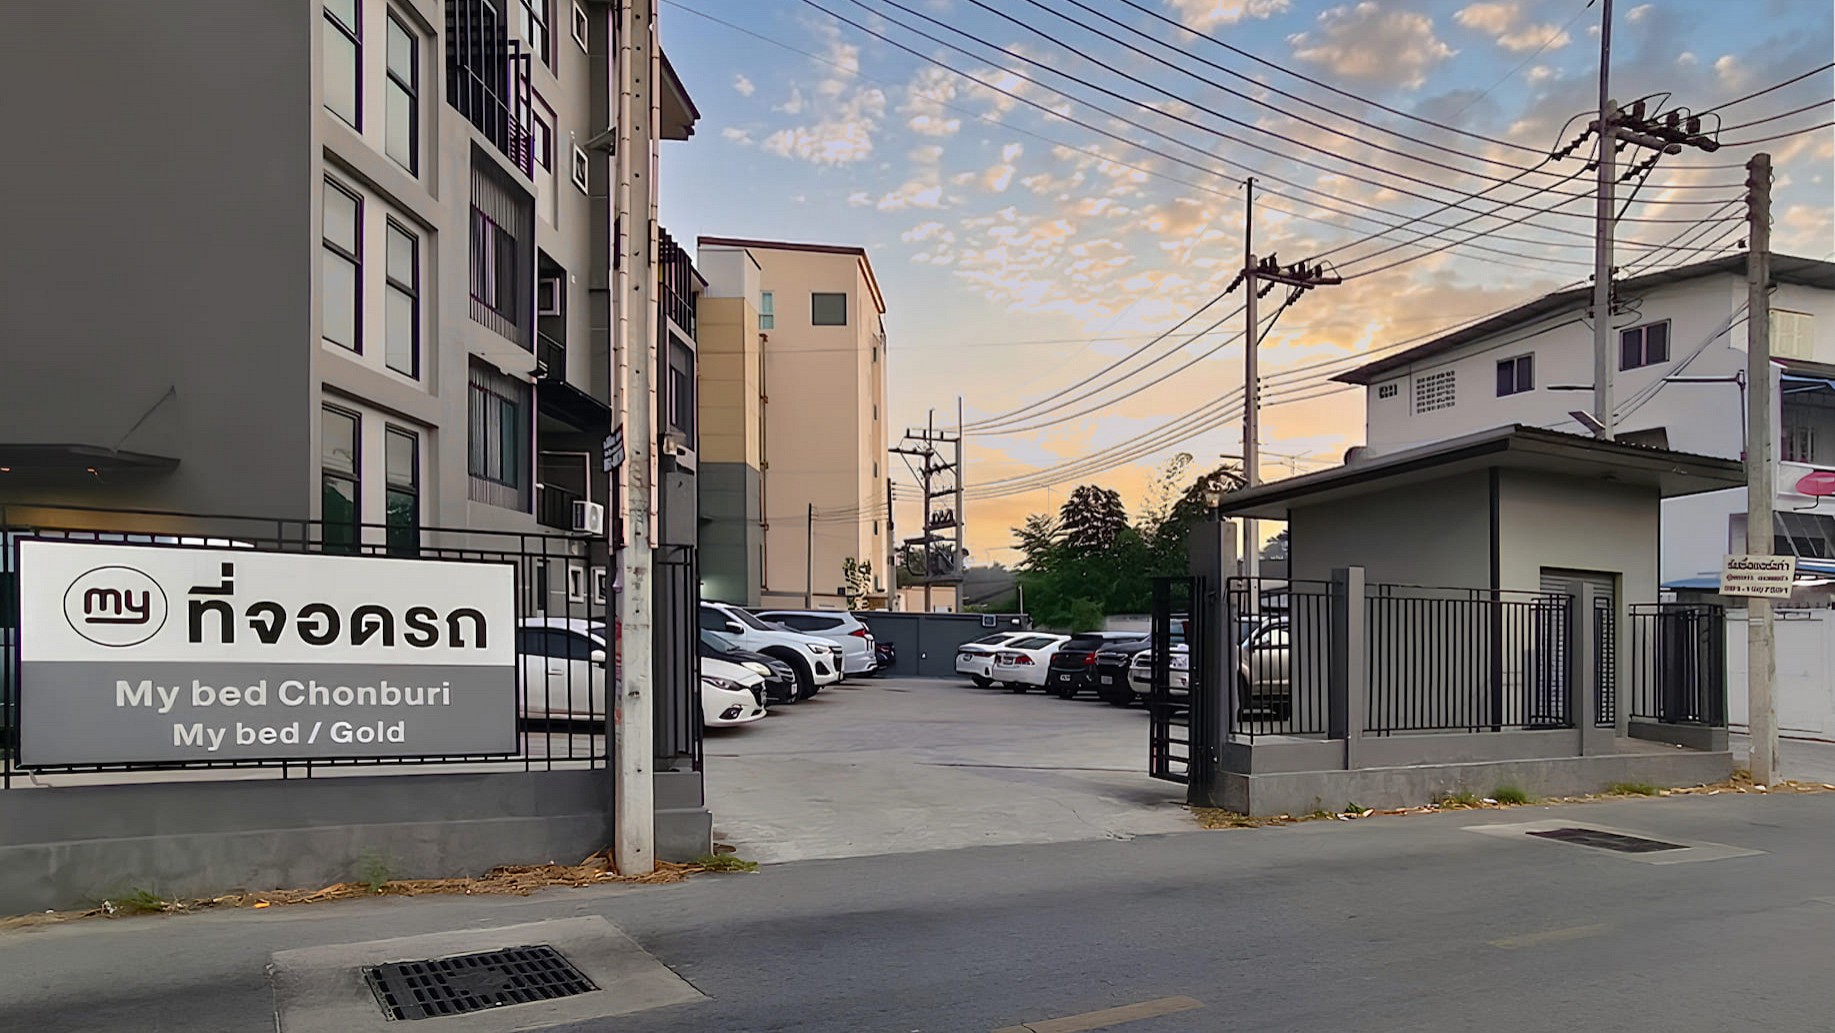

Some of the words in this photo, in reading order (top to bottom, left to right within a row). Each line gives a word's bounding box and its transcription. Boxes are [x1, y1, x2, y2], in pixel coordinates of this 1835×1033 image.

[83, 588, 150, 624] my
[187, 562, 487, 649] ที่จอดรถ
[116, 680, 180, 714] My
[192, 679, 267, 707] bed
[278, 679, 451, 707] Chonburi
[173, 723, 227, 751] My
[236, 722, 300, 745] bed
[307, 722, 323, 744] /
[330, 720, 406, 744] Gold
